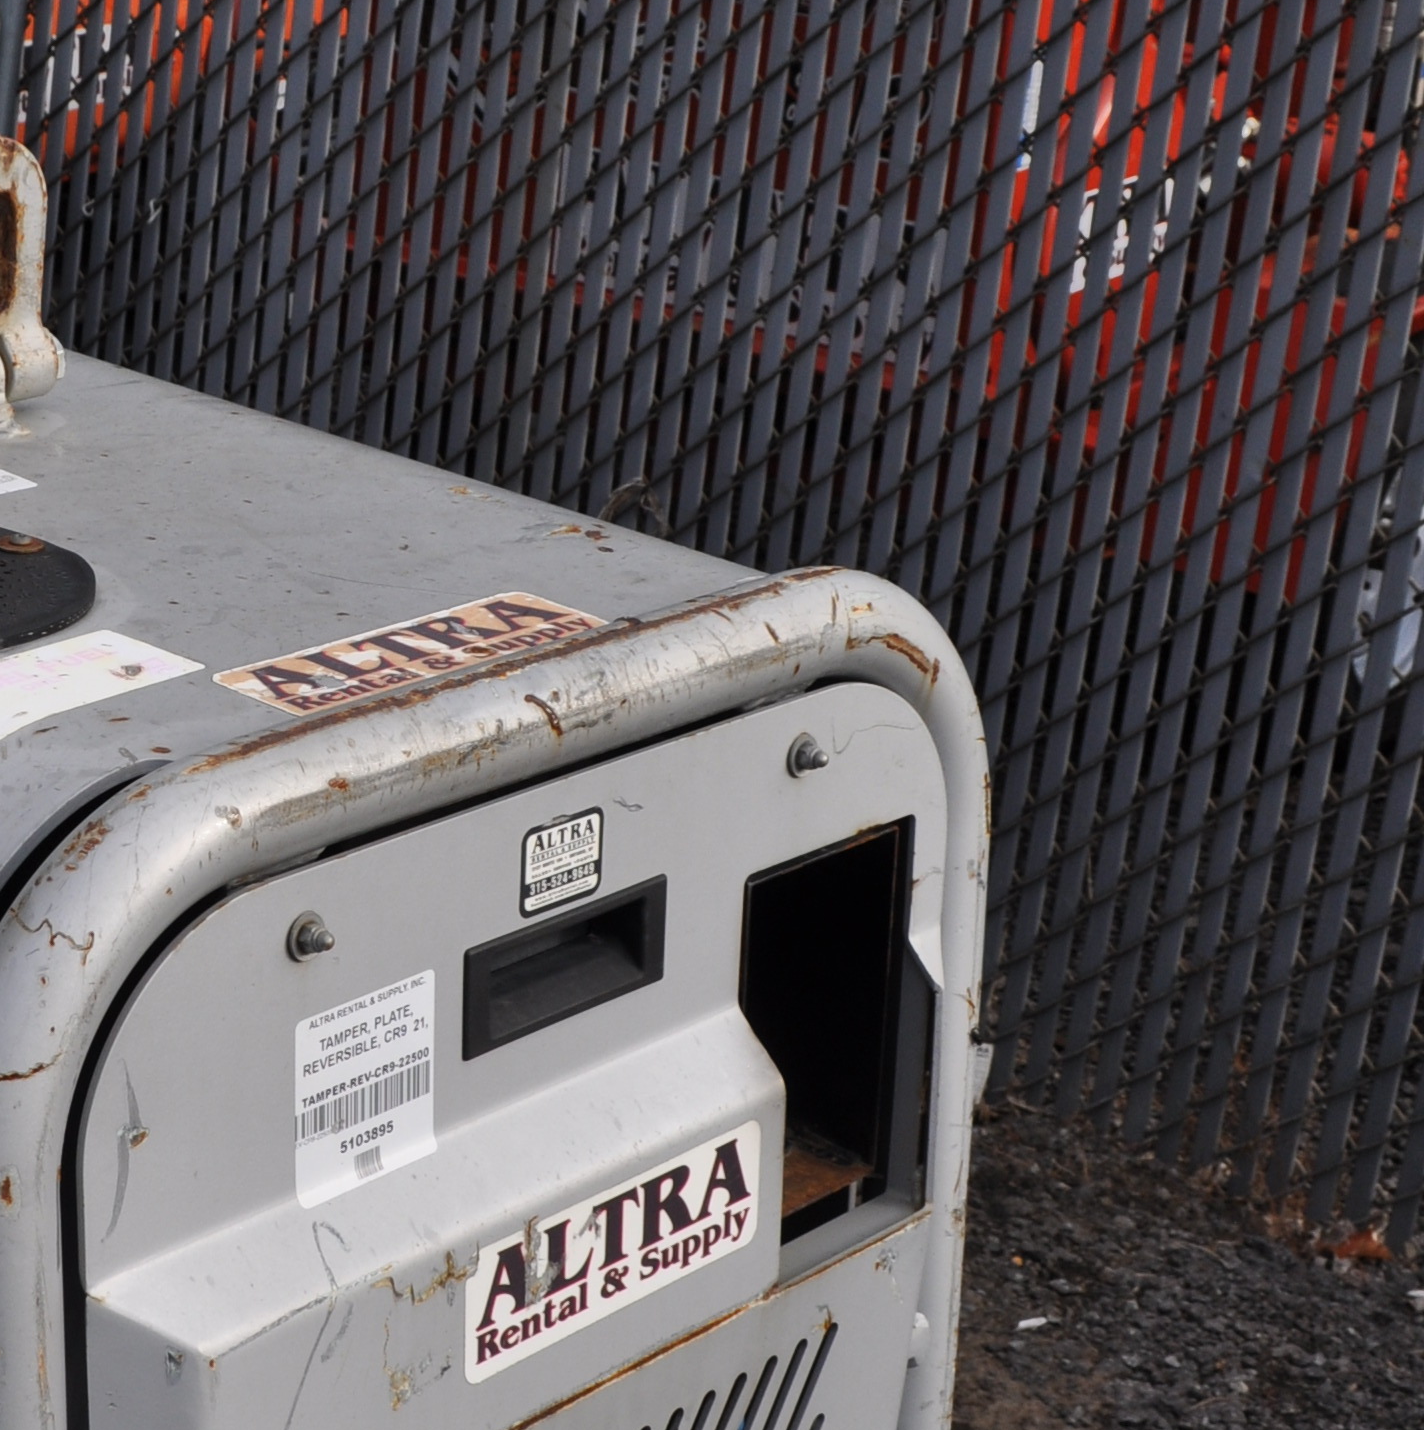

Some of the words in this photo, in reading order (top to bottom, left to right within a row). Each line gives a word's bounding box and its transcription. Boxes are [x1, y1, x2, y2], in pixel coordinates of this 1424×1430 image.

[248, 600, 572, 701] ALTRA
[282, 667, 426, 711] Rental
[422, 652, 466, 670] &
[532, 818, 595, 855] ALTRA
[308, 1013, 336, 1030] ALTRA
[337, 1000, 368, 1020] RENTAL
[369, 995, 376, 1005] &
[410, 976, 427, 990] INC.
[319, 1022, 371, 1052] TAMPER,
[374, 1004, 414, 1030] PLATE,
[303, 1037, 381, 1078] REVERSIBLE,
[384, 1024, 407, 1044] CR9
[413, 1016, 428, 1032] 21,
[301, 1047, 430, 1109] TAMPER-REV-CR9-22500
[340, 1120, 394, 1154] 5103895
[476, 1139, 752, 1331] ALTRA
[476, 1282, 589, 1365] Rental
[600, 1266, 629, 1299] &
[639, 1207, 750, 1281] Supply
